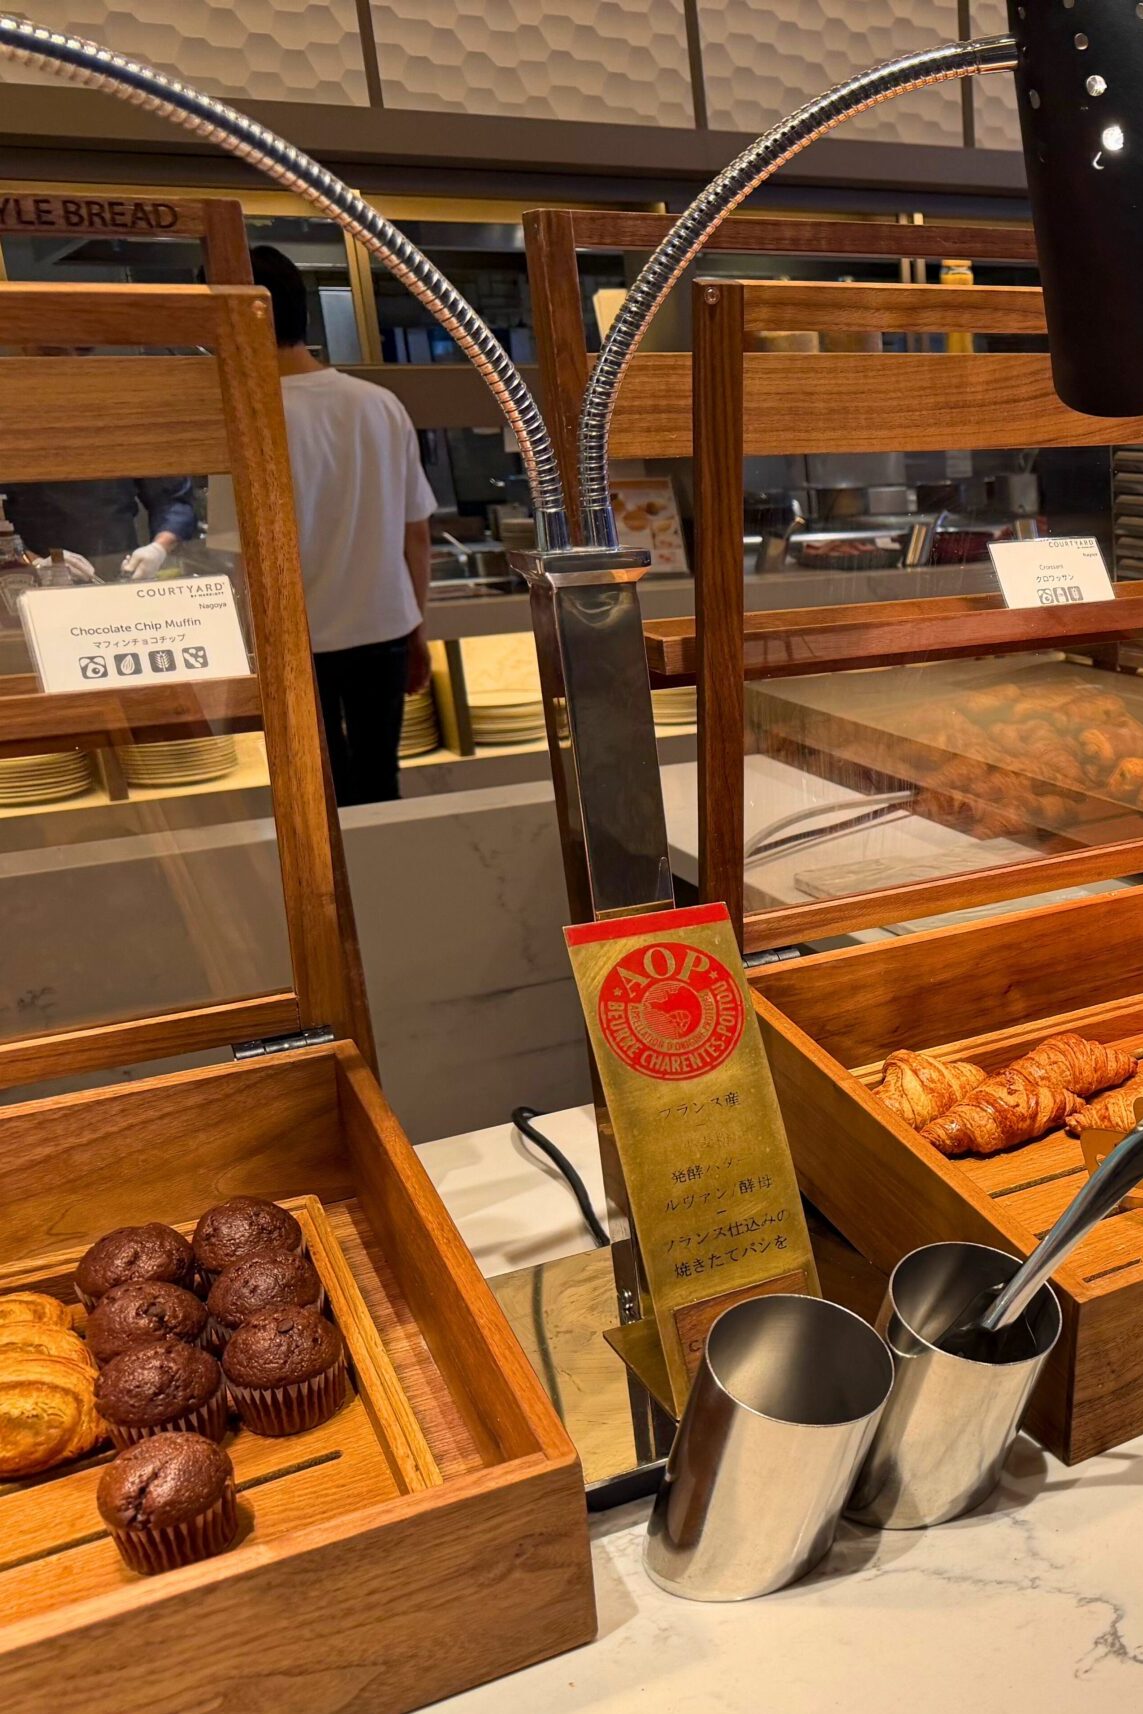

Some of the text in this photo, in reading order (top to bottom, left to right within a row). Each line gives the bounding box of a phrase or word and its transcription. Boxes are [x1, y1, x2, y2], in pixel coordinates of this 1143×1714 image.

[61, 200, 178, 229] BREAD
[1048, 539, 1094, 548] COURTYARD
[1036, 574, 1074, 583] クロワッサン
[136, 582, 223, 598] COURTYARD
[199, 602, 227, 610] Nagoya
[70, 617, 202, 637] Chocolate Chip Muffin
[93, 633, 186, 649] マフィンチョコチップ
[616, 946, 710, 999] AOP
[607, 980, 736, 1073] BEURRE CHARENTES-POITOU
[658, 1091, 740, 1120] フランス産
[674, 1234, 788, 1279] 焼きたてパンを
